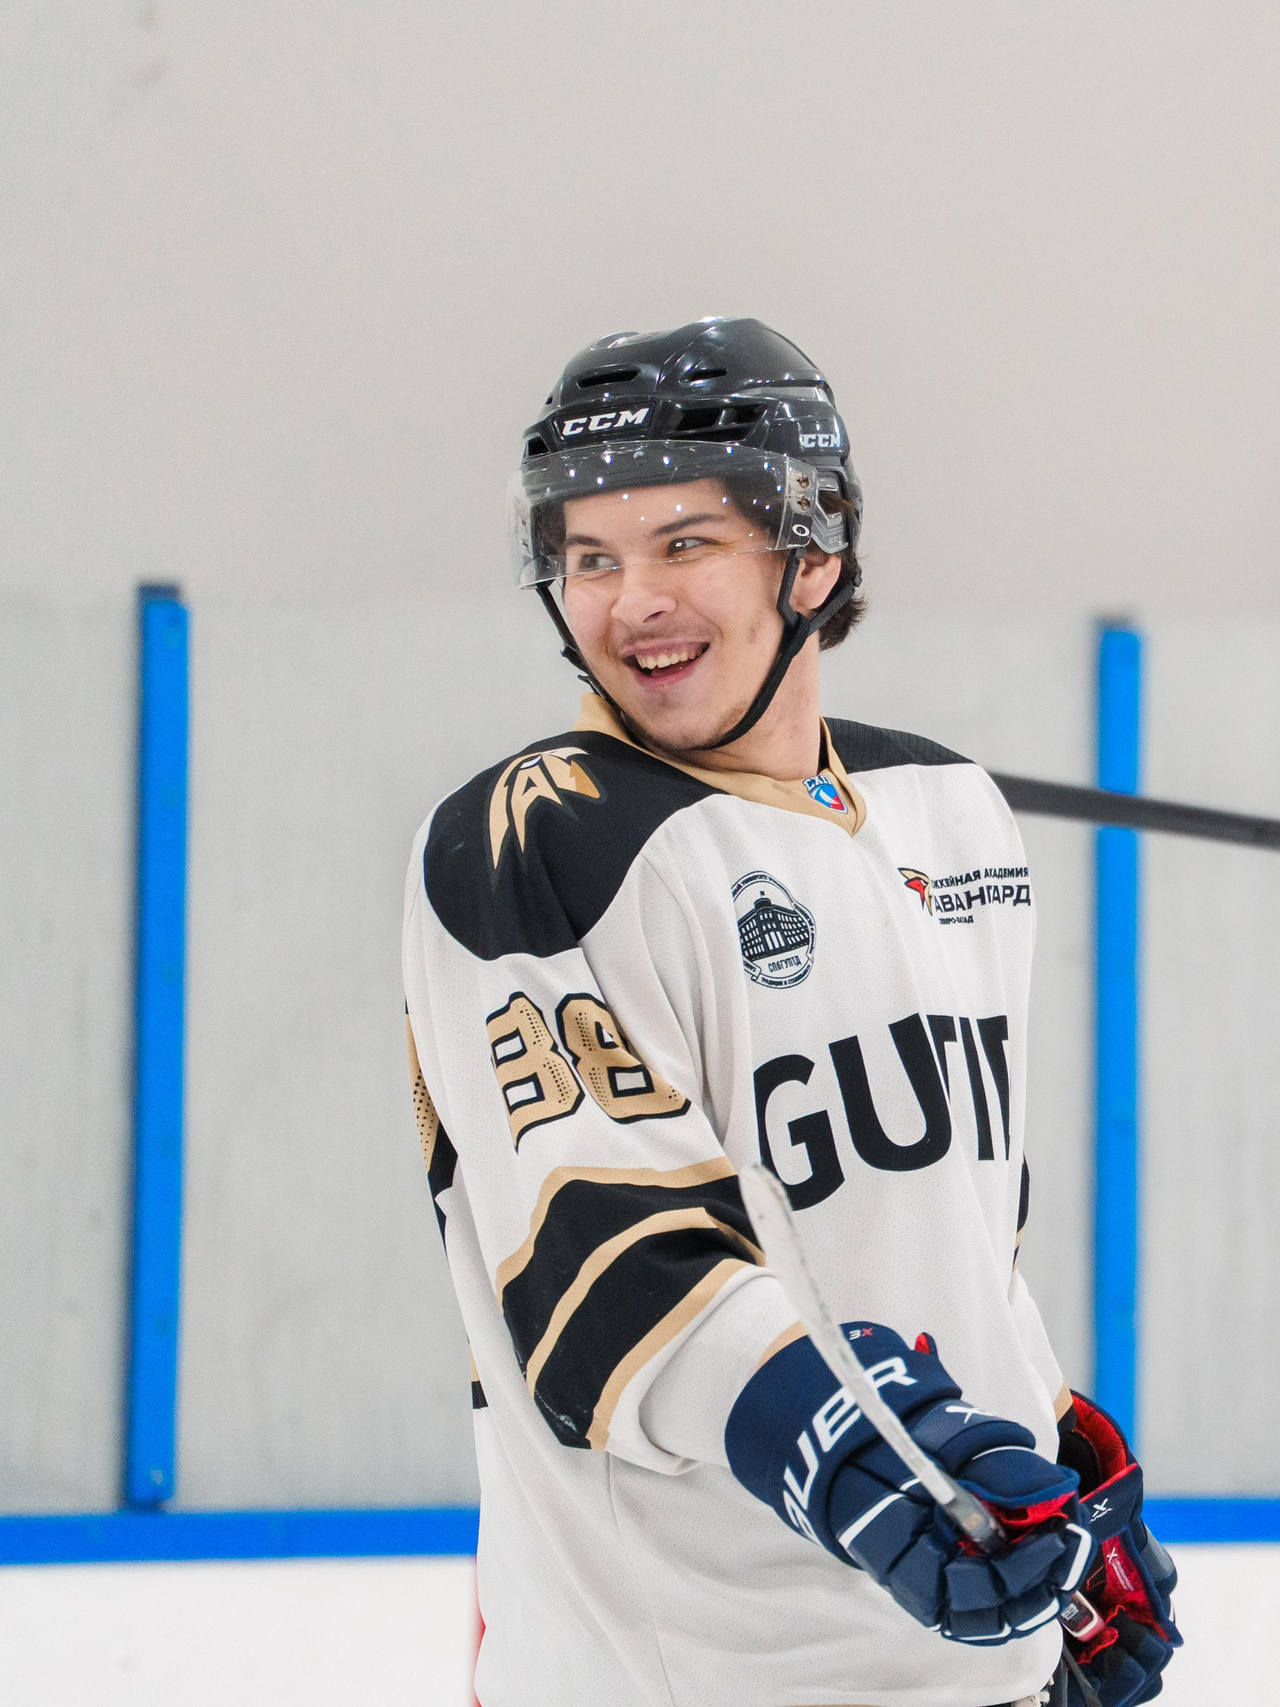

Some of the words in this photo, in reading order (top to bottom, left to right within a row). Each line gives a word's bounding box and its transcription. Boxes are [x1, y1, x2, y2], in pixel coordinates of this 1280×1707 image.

[562, 407, 649, 436] CCM
[801, 434, 841, 448] CCM
[931, 869, 981, 889] ККЕЙНАЯ
[984, 867, 1028, 879] АКАДЕМИЯ
[934, 884, 1031, 913] АВАНГАРД
[486, 991, 692, 1155] 88
[753, 1012, 1010, 1212] GUTI
[849, 1327, 874, 1340] 3X
[783, 1356, 919, 1552] AUER
